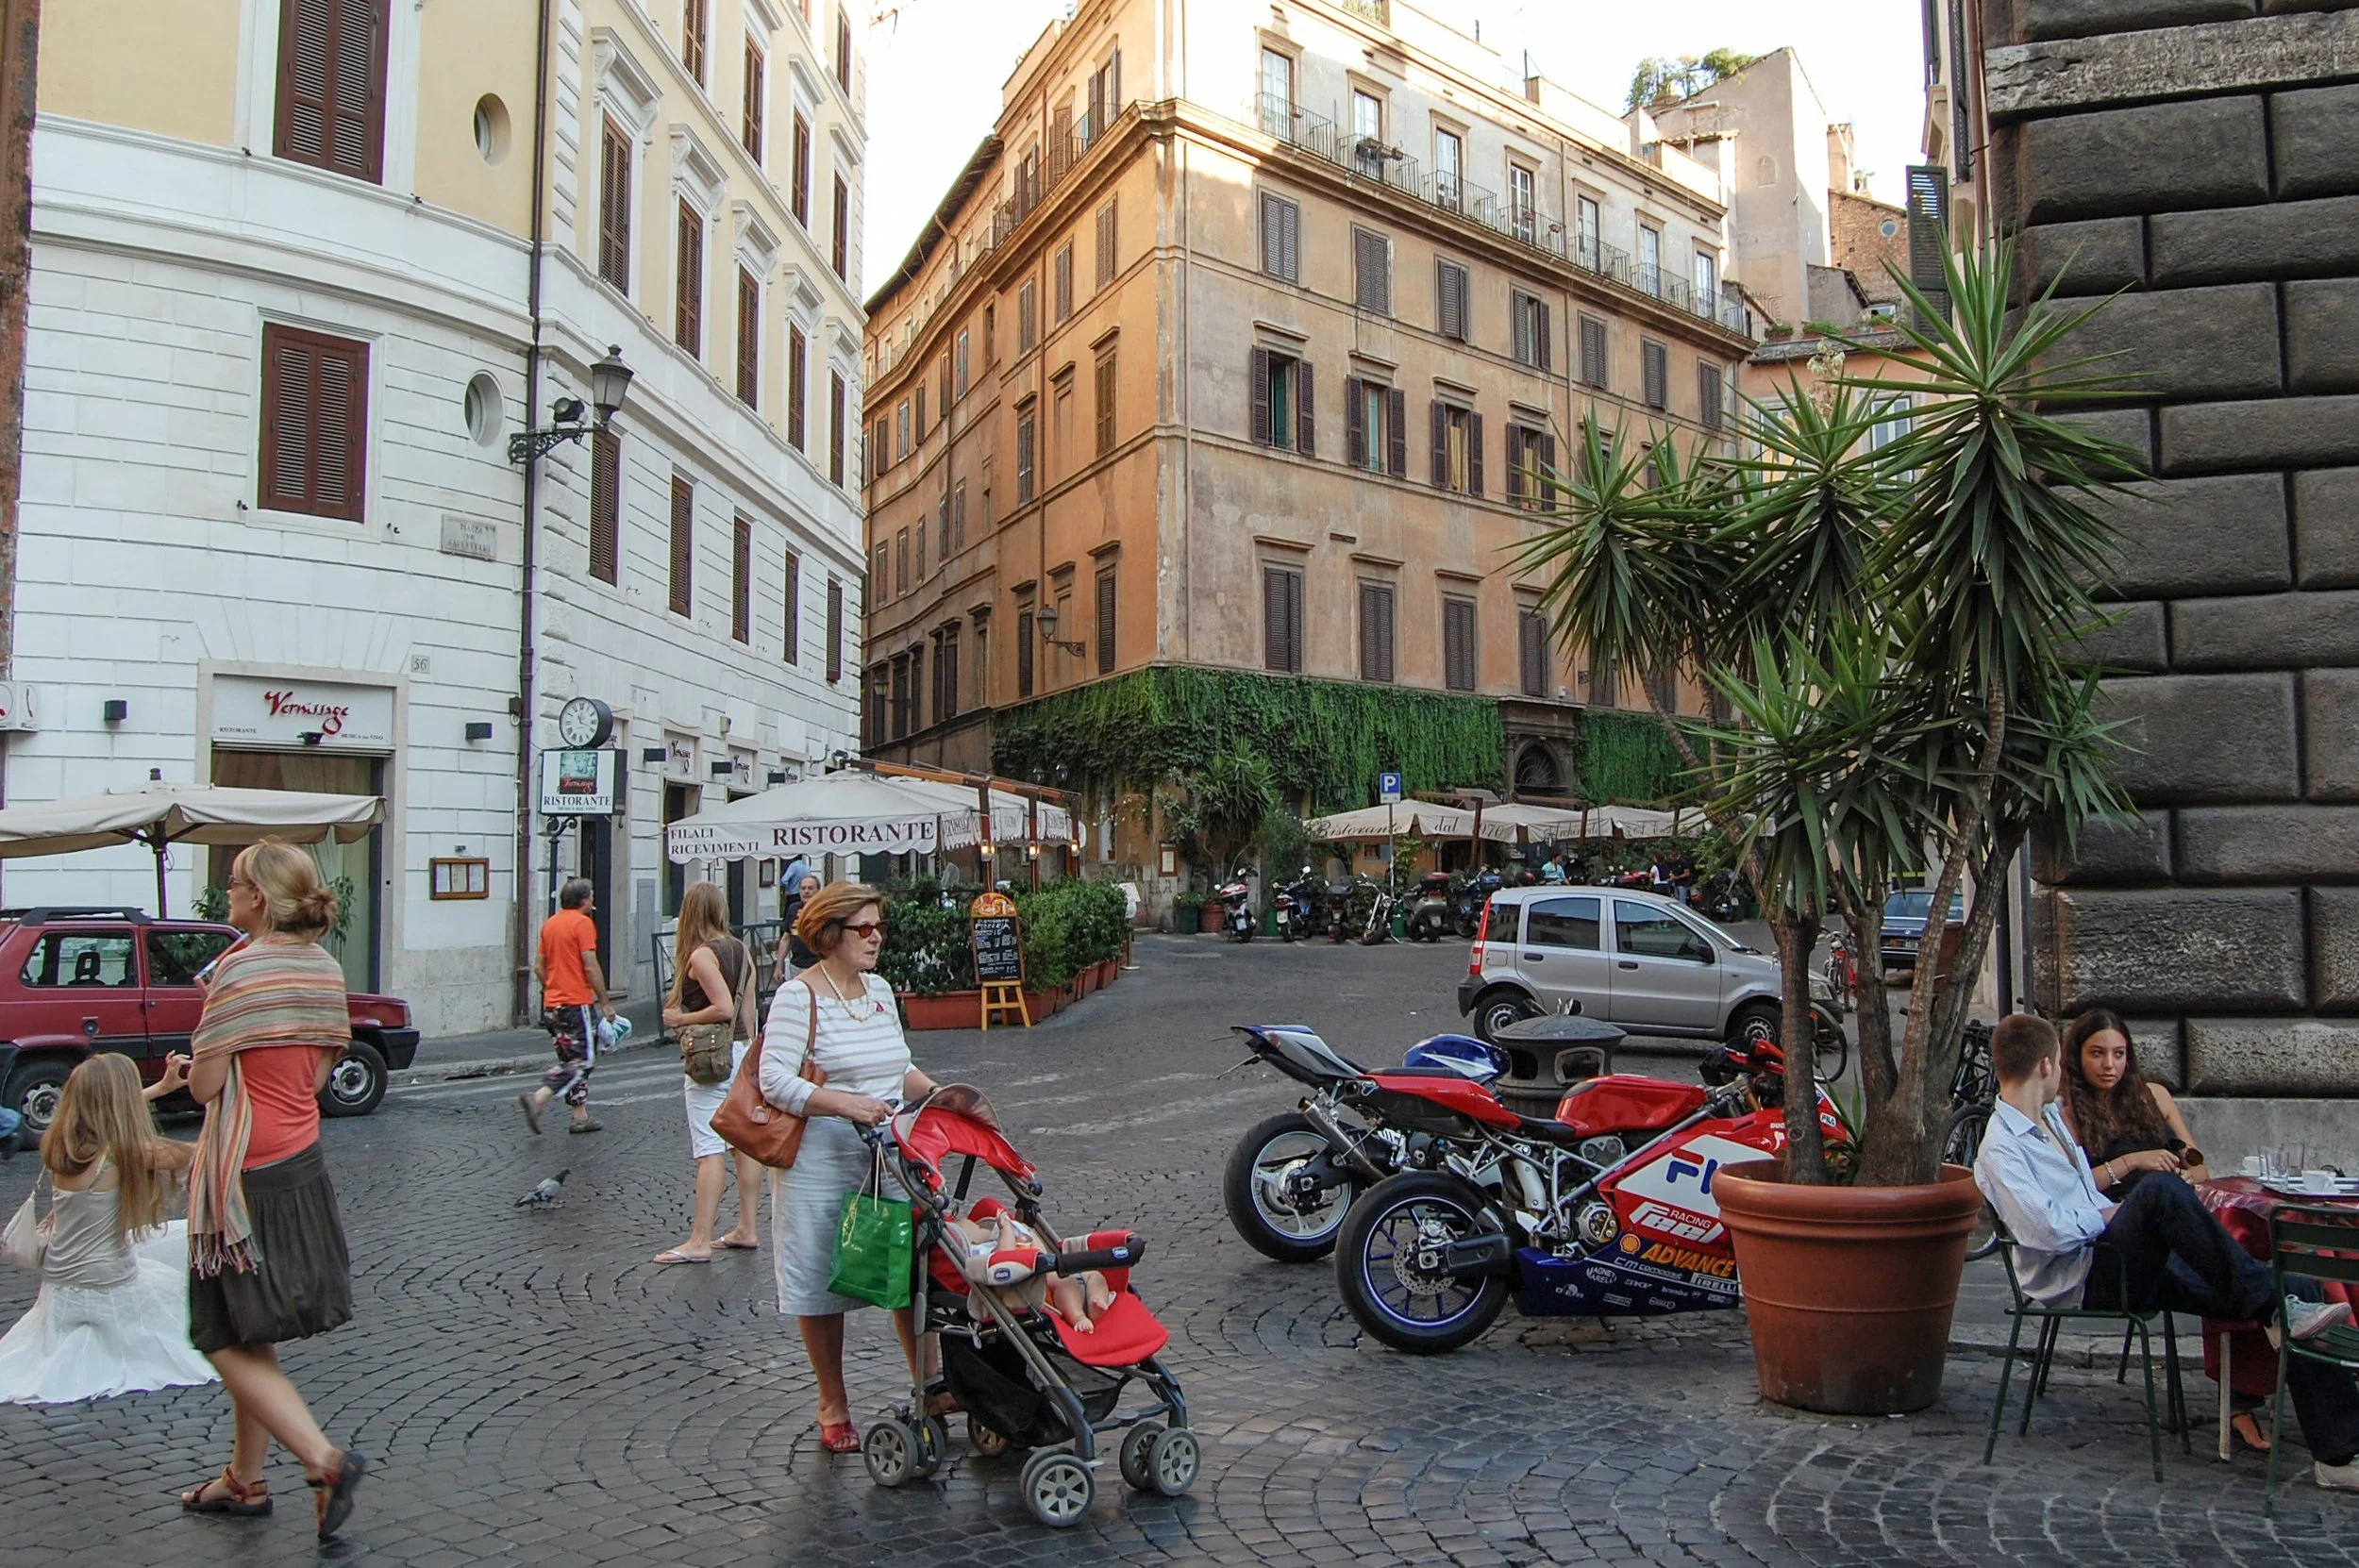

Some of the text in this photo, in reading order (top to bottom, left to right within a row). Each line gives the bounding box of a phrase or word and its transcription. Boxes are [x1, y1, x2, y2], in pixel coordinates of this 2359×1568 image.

[413, 658, 427, 671] 56
[264, 691, 349, 735] Vernissage
[1384, 776, 1397, 792] P
[544, 795, 611, 807] RISTORANTE
[1434, 816, 1459, 833] dal
[671, 827, 713, 840] FILALI
[772, 821, 935, 847] RISTORANTE
[671, 842, 759, 855] RICEVIMENTI
[1821, 1114, 1835, 1126] FILA
[1670, 1209, 1712, 1229] RACING
[1640, 1243, 1737, 1278] ADVANCE
[1690, 1272, 1737, 1293] PIRELLI
